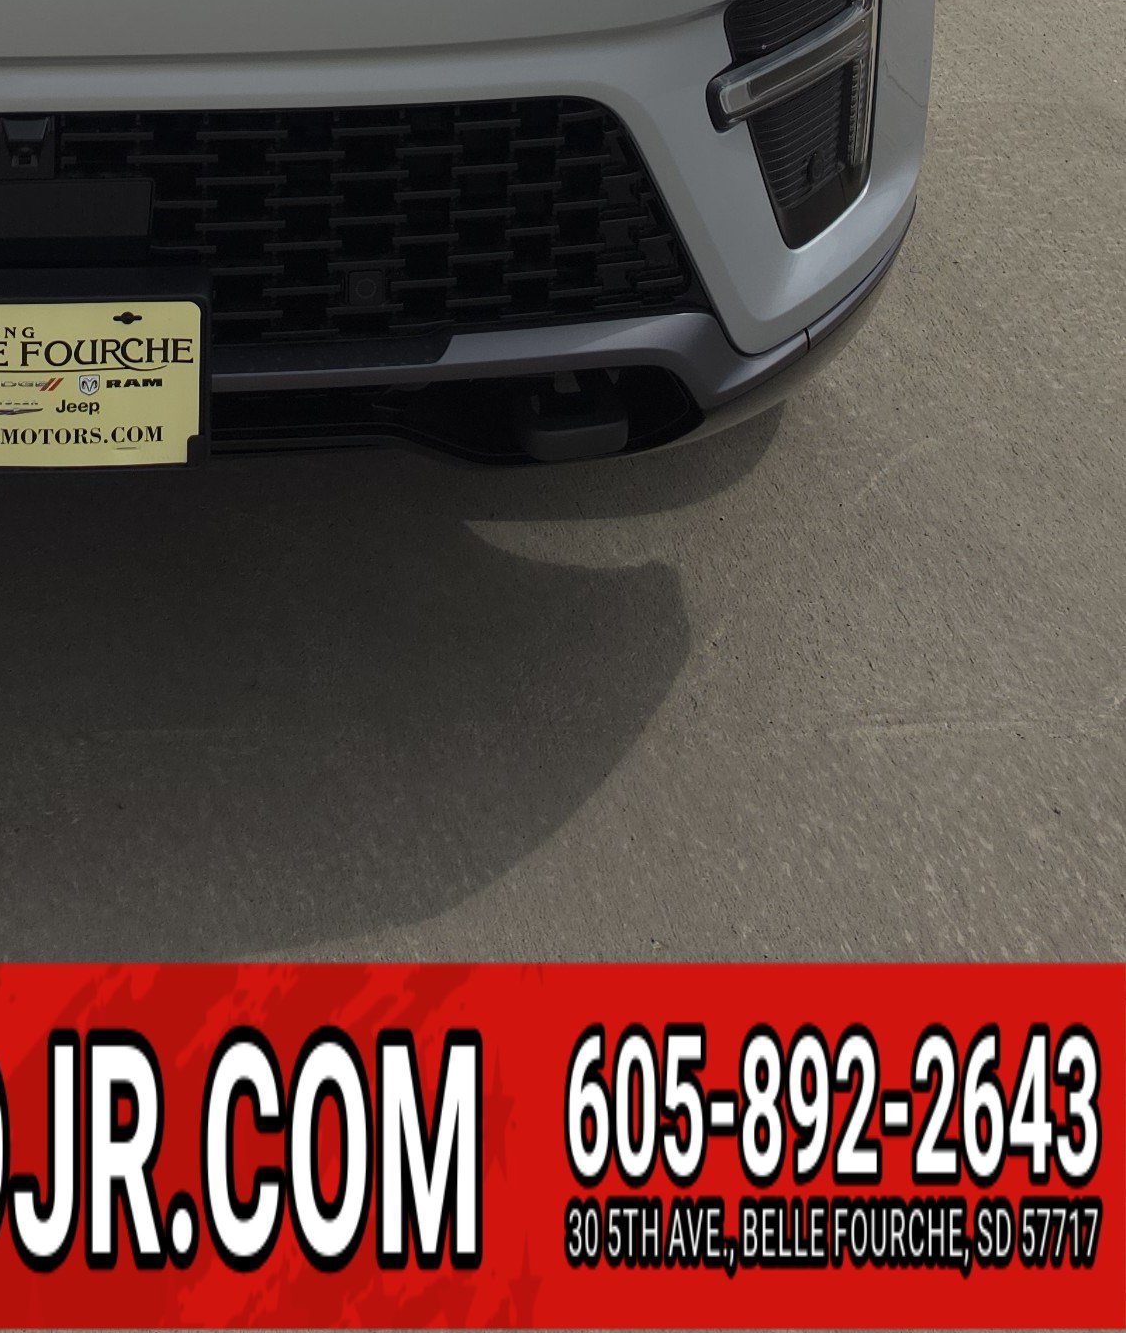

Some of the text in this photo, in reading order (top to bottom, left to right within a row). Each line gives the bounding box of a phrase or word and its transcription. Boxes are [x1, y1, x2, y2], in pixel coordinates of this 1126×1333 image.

[20, 337, 194, 371] FOURCHE
[106, 378, 163, 388] RAM
[55, 399, 100, 415] Jeep
